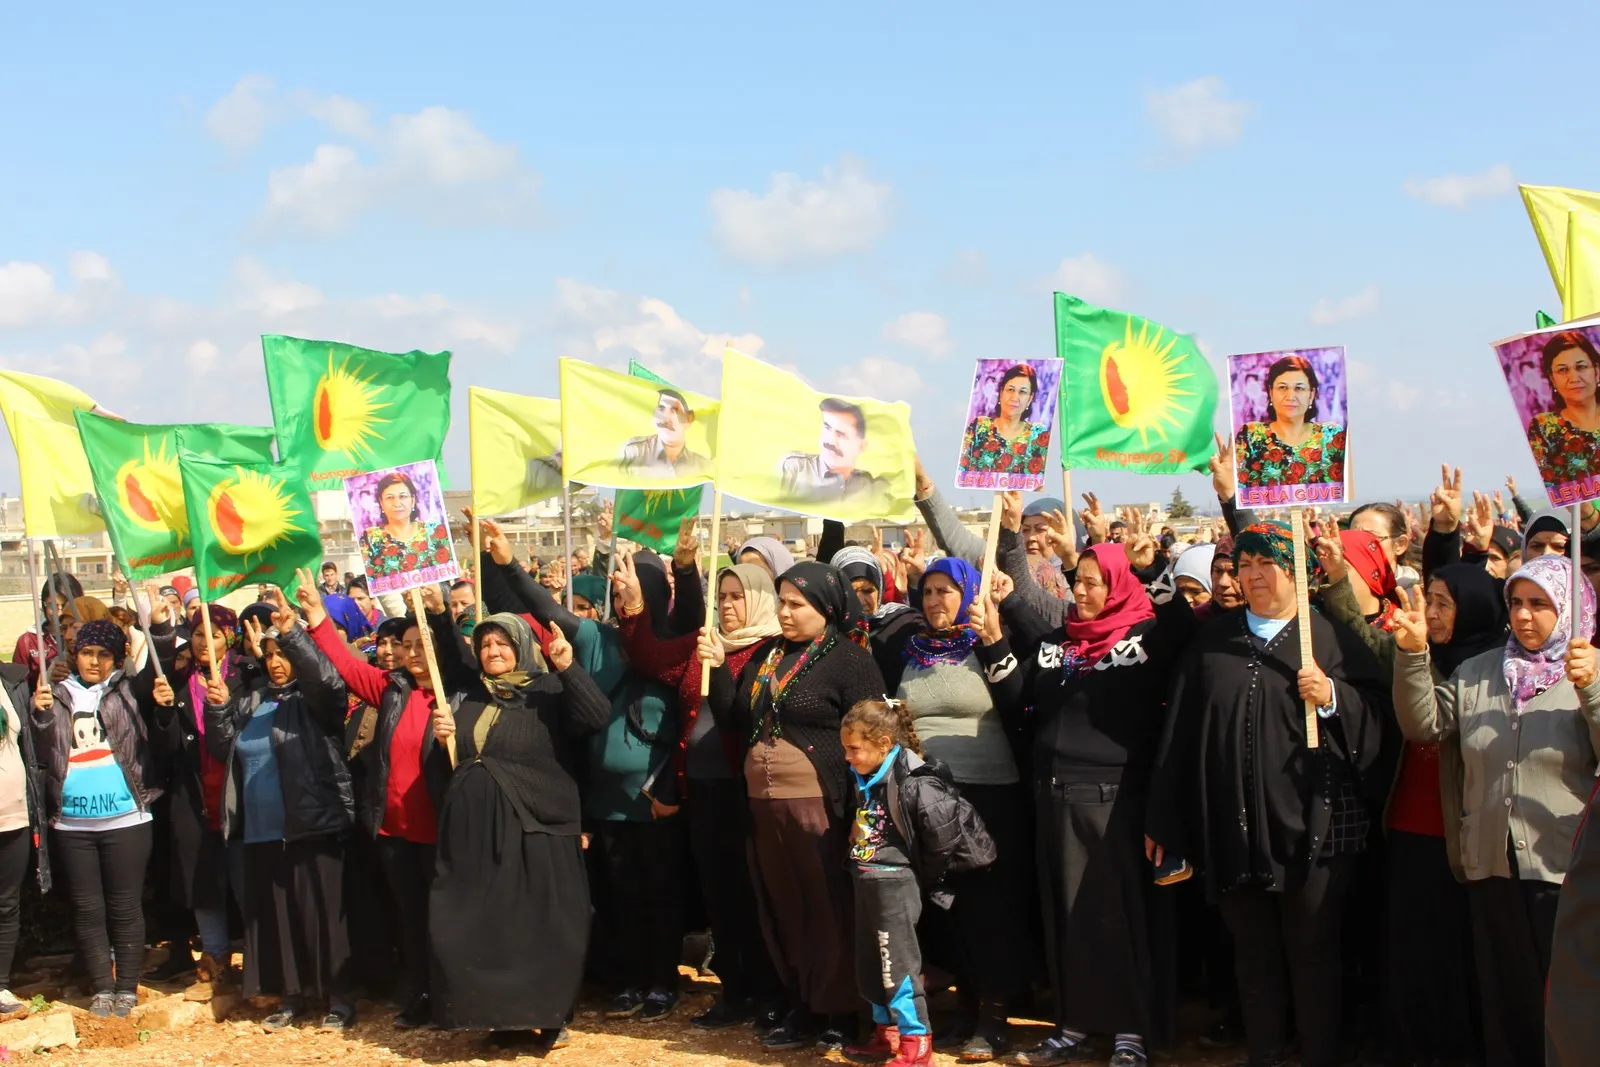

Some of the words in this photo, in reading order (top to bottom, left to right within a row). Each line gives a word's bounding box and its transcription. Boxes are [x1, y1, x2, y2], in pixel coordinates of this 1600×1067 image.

[958, 474, 996, 487] LEYLA
[1549, 480, 1600, 504] LEYLA
[1240, 488, 1290, 504] LEYLA
[1295, 486, 1344, 502] GUVE
[72, 792, 119, 815] FRANK
[877, 929, 895, 989] MEOW
